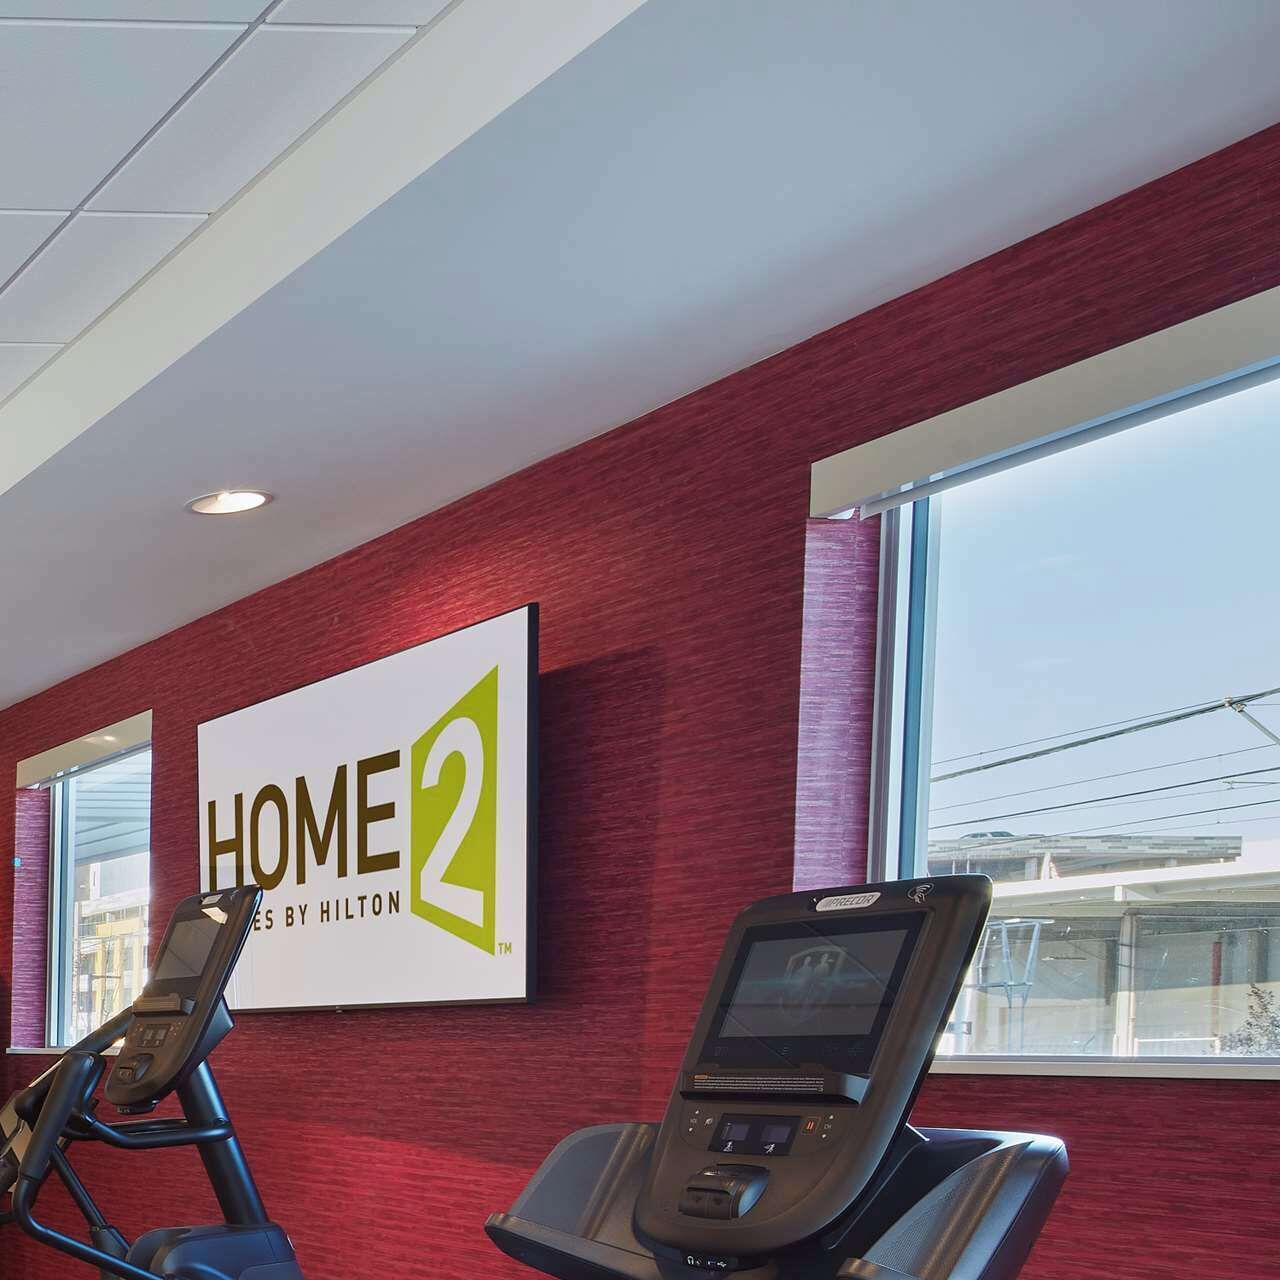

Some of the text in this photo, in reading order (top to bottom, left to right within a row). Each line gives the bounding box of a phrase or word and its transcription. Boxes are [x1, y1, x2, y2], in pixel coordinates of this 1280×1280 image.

[208, 750, 400, 891] HOME
[285, 904, 308, 927] BY
[320, 890, 400, 923] HILTON
